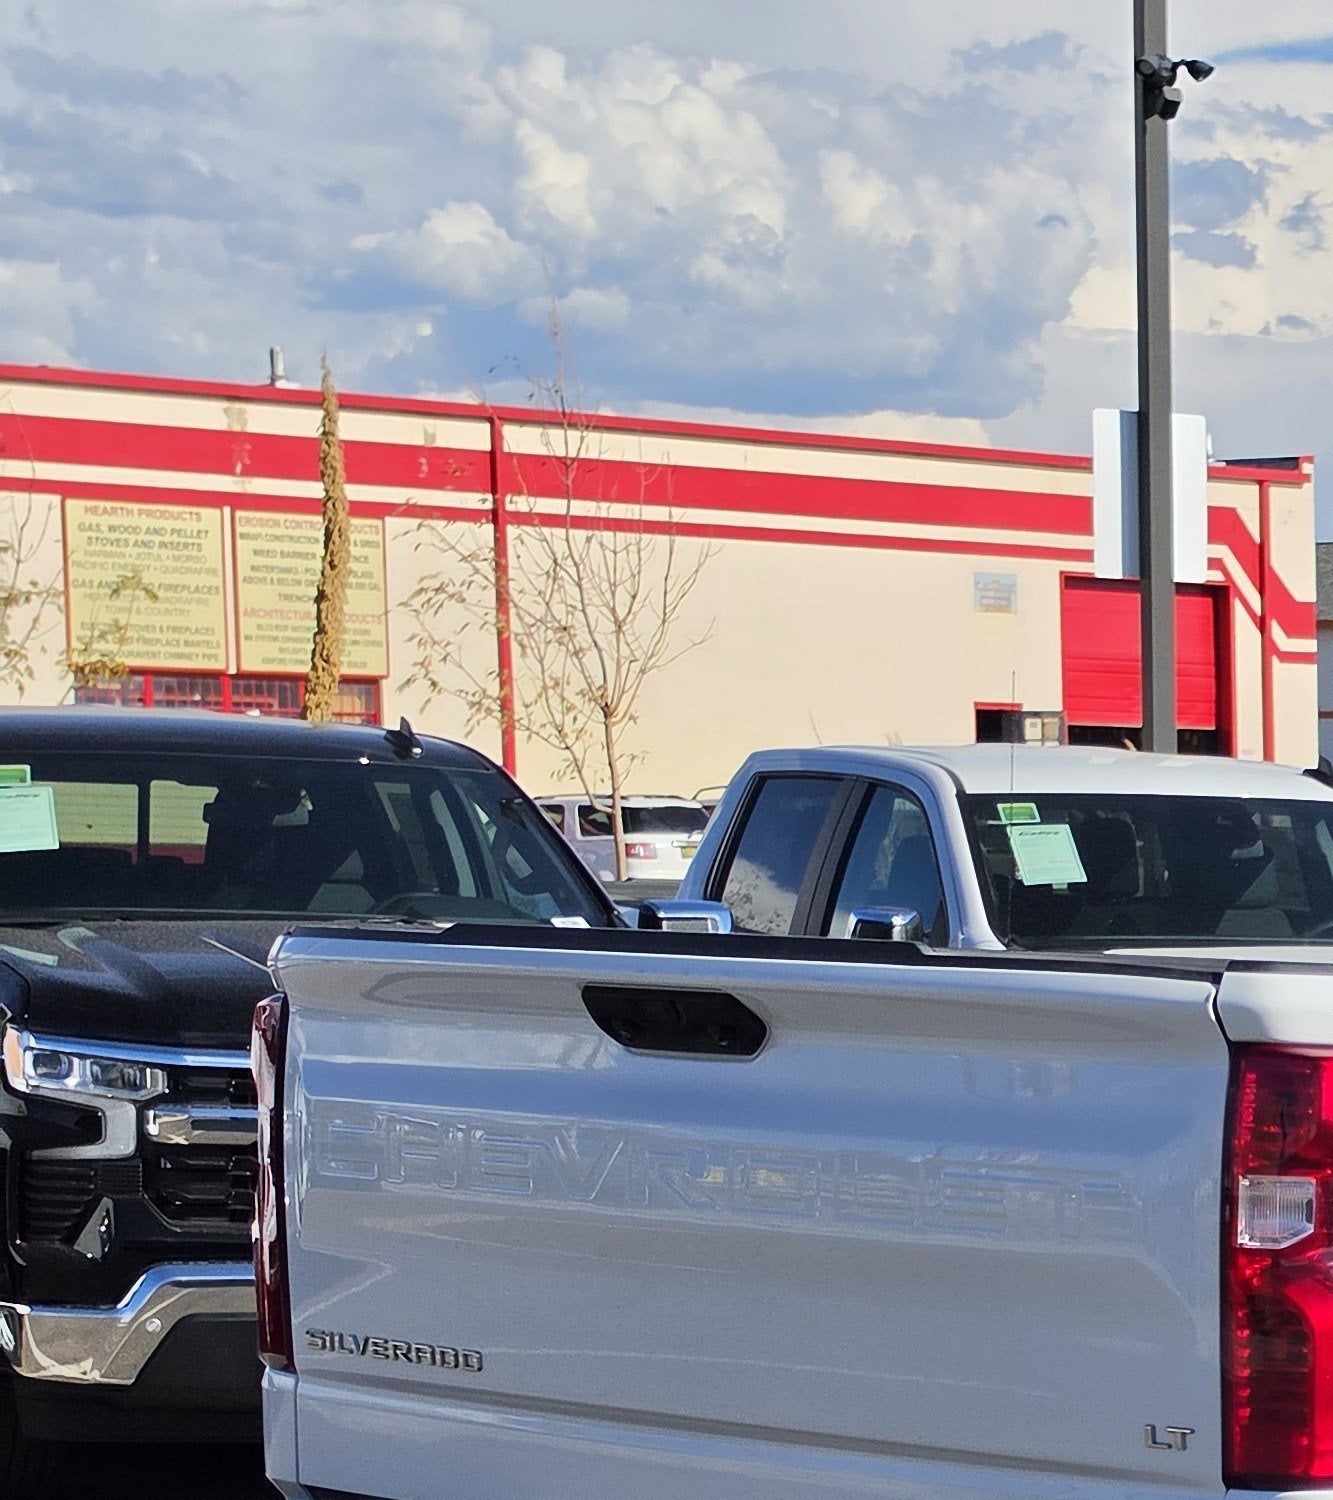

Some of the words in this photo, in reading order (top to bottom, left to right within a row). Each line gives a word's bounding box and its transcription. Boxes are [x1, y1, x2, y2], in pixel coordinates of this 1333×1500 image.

[84, 505, 134, 518] HEARTH
[138, 508, 203, 522] PRODUCTS
[77, 521, 104, 534] GAS,
[108, 524, 142, 535] WOOD
[144, 526, 167, 537] AND
[170, 528, 210, 540] PELLET
[238, 515, 281, 528] EROSION
[283, 517, 324, 531] CONTRO
[86, 536, 130, 548] STOVES
[132, 539, 155, 550] AND
[158, 541, 203, 552] INSERTS
[71, 578, 94, 589] GAS
[97, 580, 118, 590] AN
[243, 607, 313, 621] ARCHITECTUR
[306, 1328, 484, 1373] SILVERADO
[1144, 1424, 1196, 1451] LT
